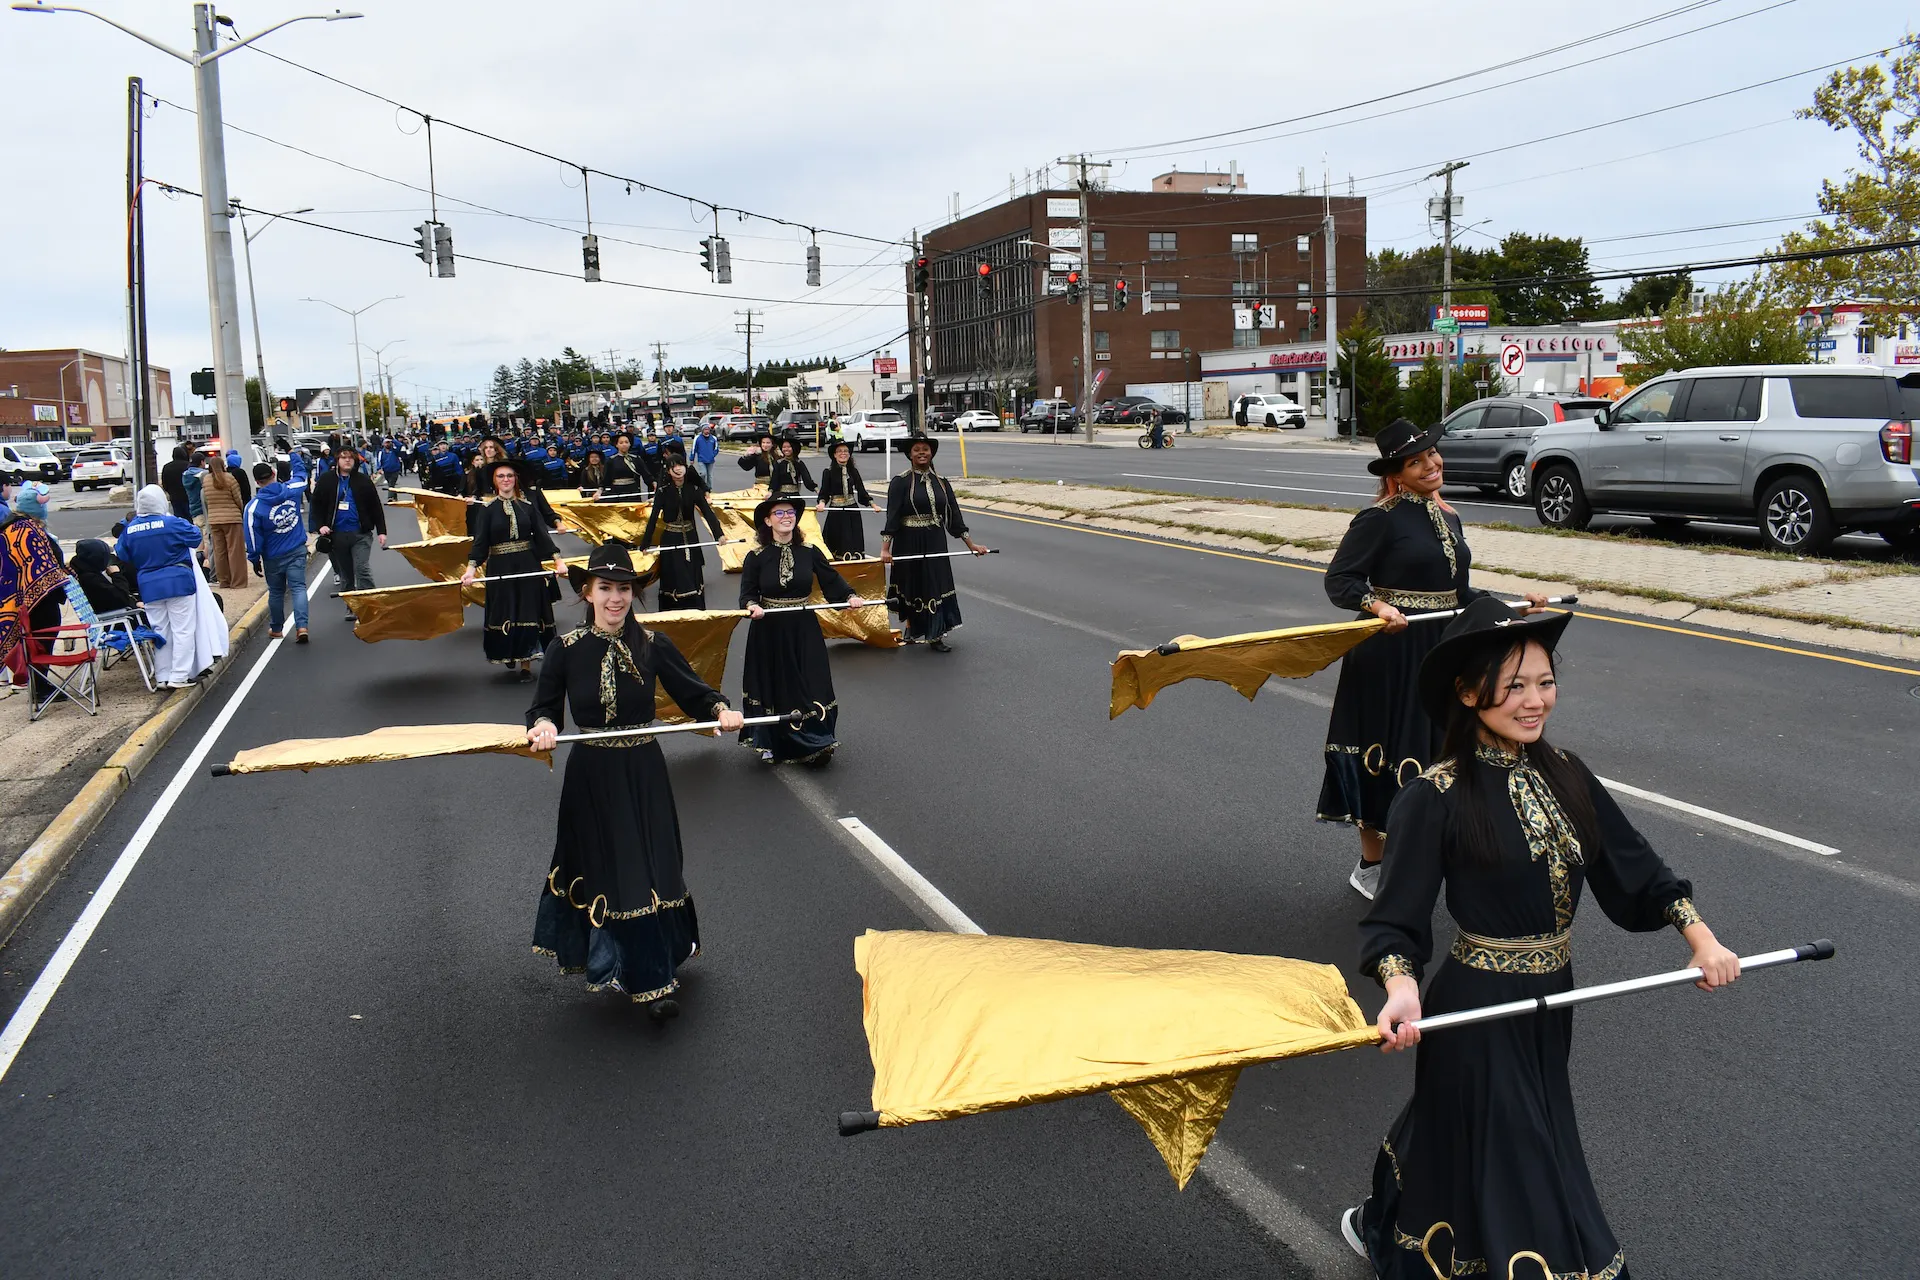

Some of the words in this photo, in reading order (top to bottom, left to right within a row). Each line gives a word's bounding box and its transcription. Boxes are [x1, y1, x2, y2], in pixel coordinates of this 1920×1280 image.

[1438, 308, 1487, 319] Frestone
[924, 295, 932, 371] 3000
[1501, 334, 1607, 351] restone
[901, 383, 914, 394] 3000
